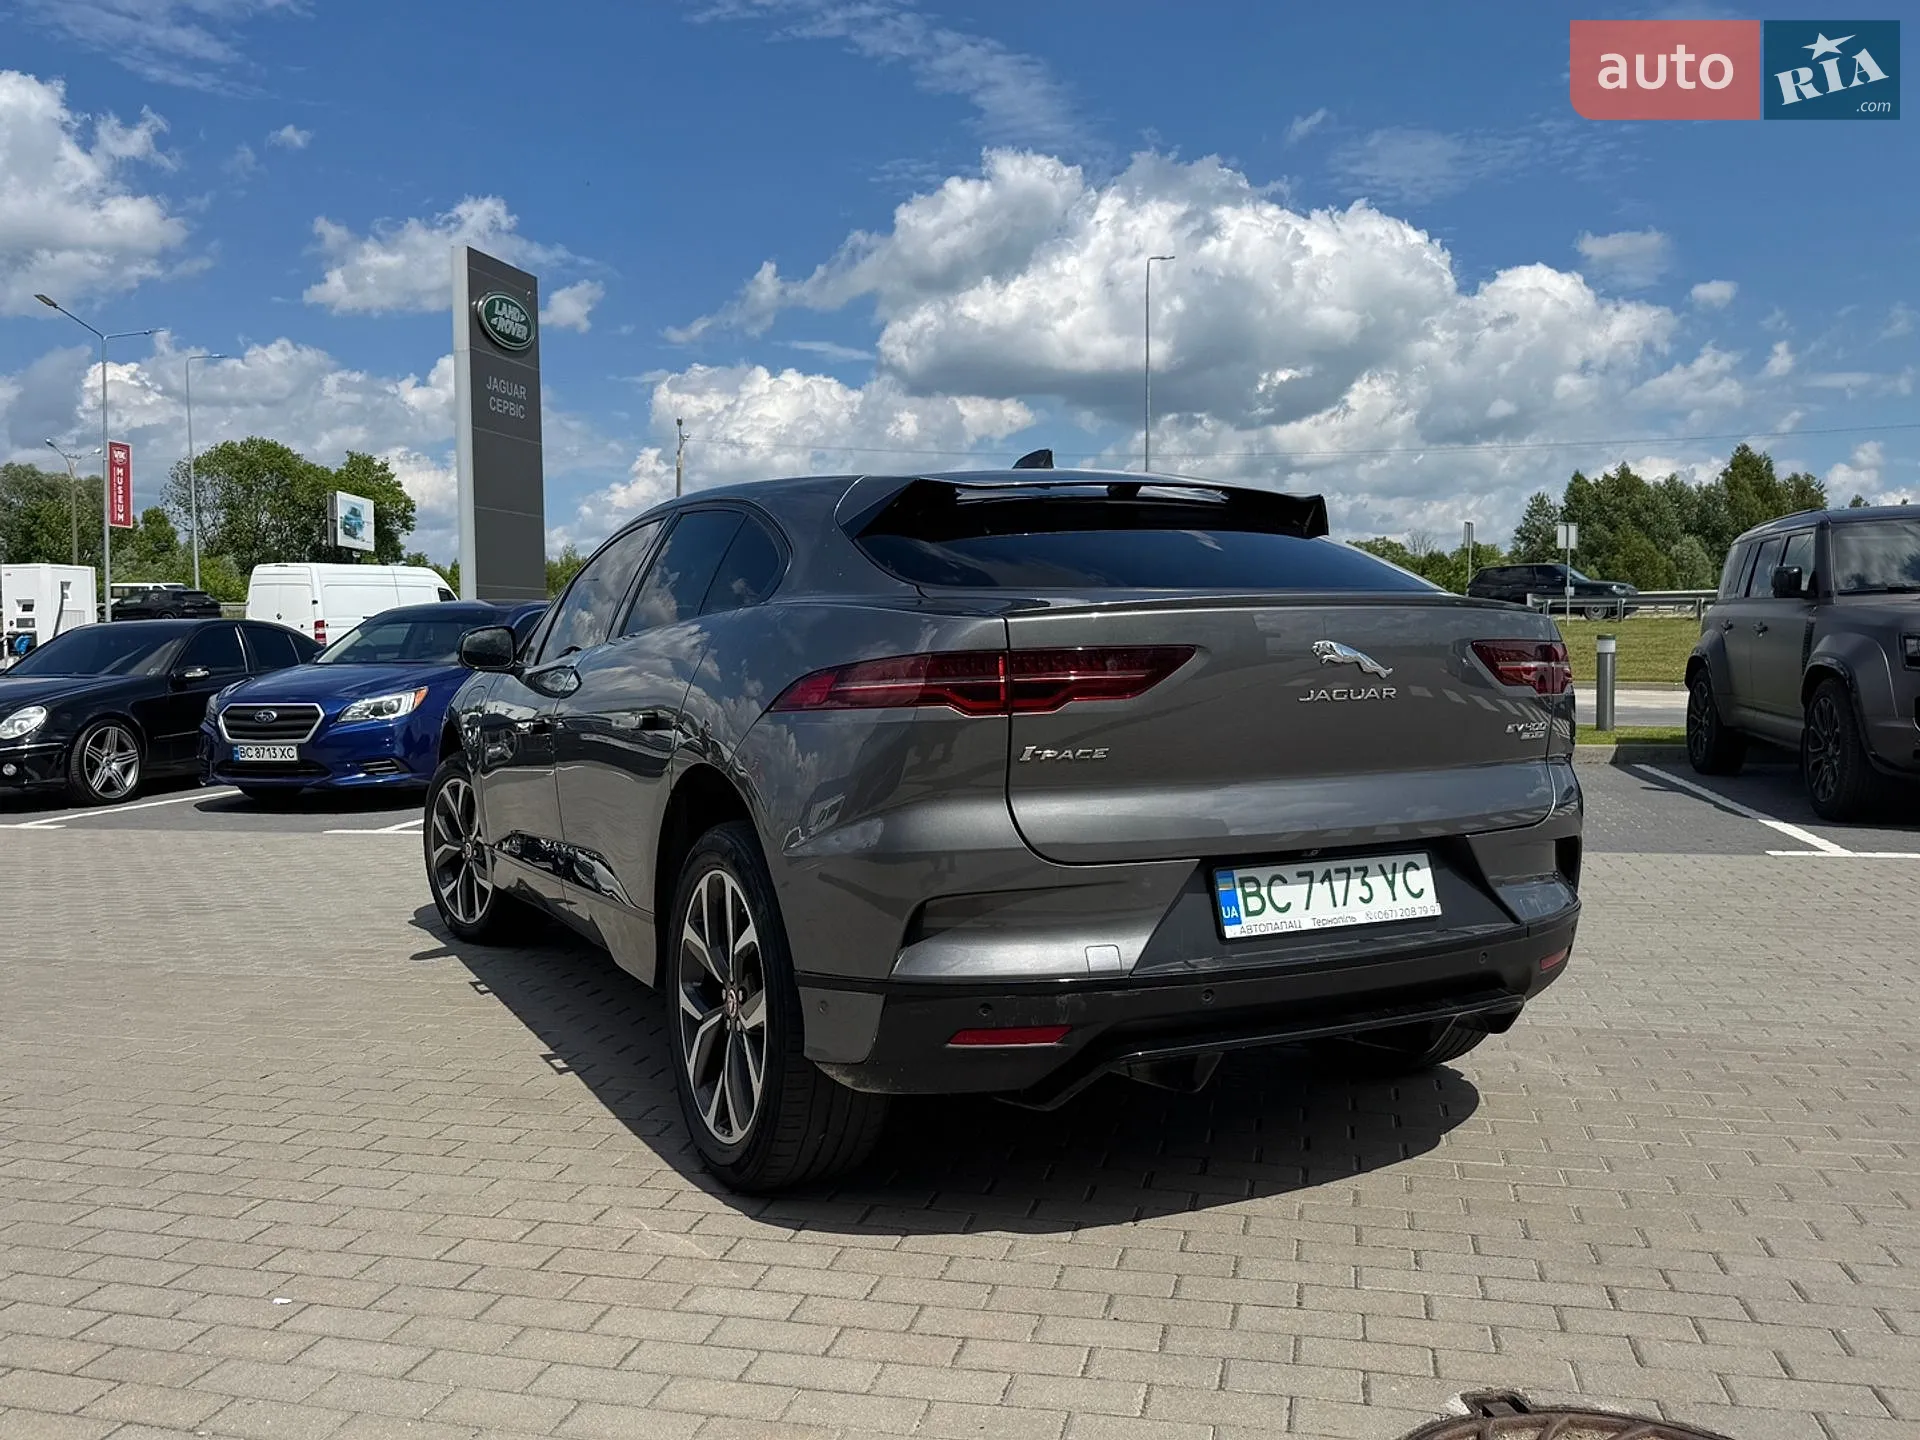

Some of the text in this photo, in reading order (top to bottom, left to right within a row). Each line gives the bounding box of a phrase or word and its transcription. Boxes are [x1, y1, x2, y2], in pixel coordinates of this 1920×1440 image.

[494, 299, 521, 323] LAND
[496, 316, 528, 341] ROVER
[486, 376, 527, 401] JAGUAR
[489, 396, 525, 420] СЕРВІС
[116, 467, 124, 522] MUSEUM
[1298, 687, 1397, 701] JAGUAR
[239, 746, 295, 759] BC 8713 XC
[1238, 861, 1425, 918] BC 7173 YC
[1222, 905, 1240, 919] UA
